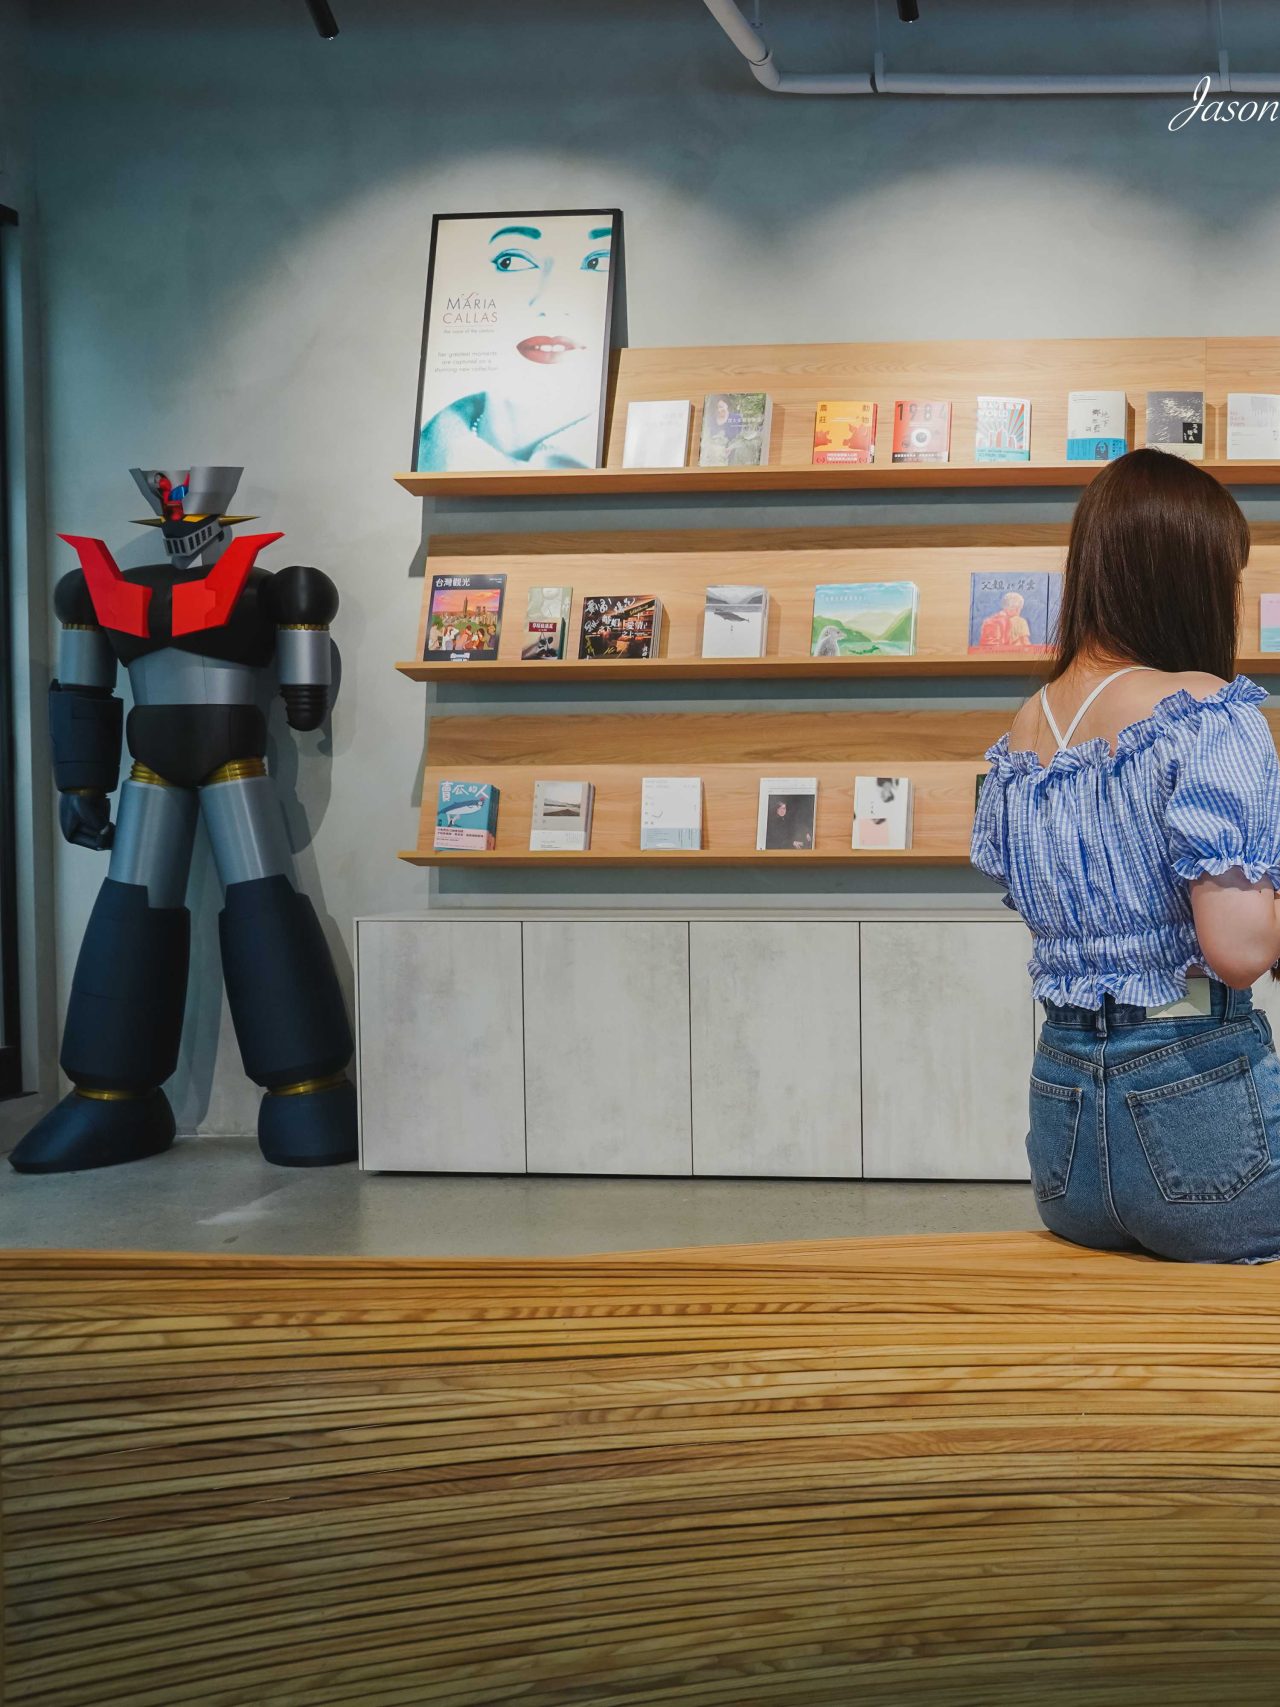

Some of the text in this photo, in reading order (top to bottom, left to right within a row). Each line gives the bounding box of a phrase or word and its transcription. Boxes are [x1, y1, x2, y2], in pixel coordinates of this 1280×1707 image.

[447, 297, 496, 310] MARIA
[442, 311, 498, 324] CALLAS
[435, 577, 471, 587] 台灣觀光
[441, 781, 489, 802] 賣瓜的人
